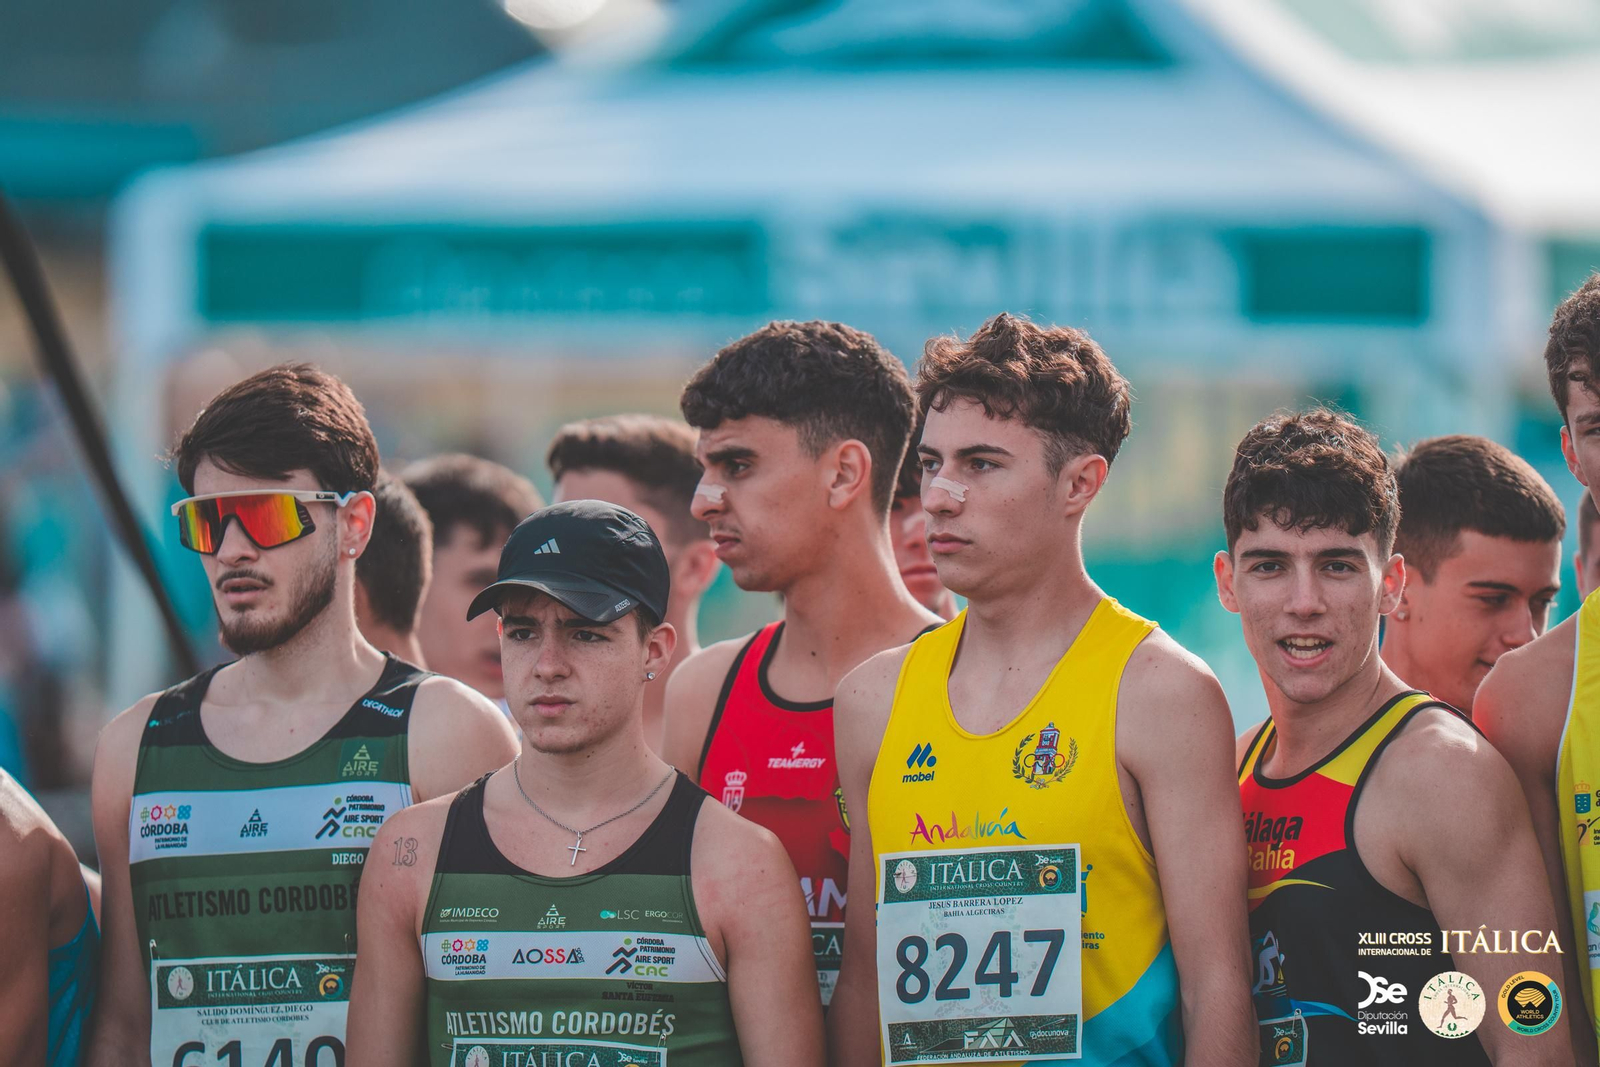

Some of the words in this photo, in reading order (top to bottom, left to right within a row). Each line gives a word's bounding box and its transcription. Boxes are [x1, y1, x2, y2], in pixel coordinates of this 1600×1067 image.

[902, 771, 935, 783] mobel
[346, 794, 374, 803] CÓRDOBA
[343, 815, 360, 823] AIRE
[361, 815, 384, 823] SPORT
[140, 822, 189, 838] CÓRDOBA
[342, 826, 377, 838] CAC
[909, 807, 1027, 845] Andalucía
[1242, 811, 1304, 851] álaga
[392, 837, 419, 867] 13
[332, 853, 364, 865] DIEGO
[929, 856, 1023, 885] ITÁLICA
[148, 888, 250, 922] ATLETISMO
[258, 877, 359, 914] CORDOBÉ
[928, 900, 951, 910] JESUS
[952, 898, 992, 908] BARRERA
[993, 896, 1023, 906] LOPEZ
[452, 907, 499, 918] IMDECO
[617, 909, 640, 920] LSC
[943, 909, 964, 918] BAHIA
[965, 908, 1005, 916] ALGECIRAS
[636, 937, 664, 946] CÓRDOBA
[640, 945, 676, 954] PATRIMONIO
[441, 953, 487, 965] CÓRDOBA
[512, 948, 579, 964] AOSSA
[635, 955, 651, 963] AIRE
[653, 955, 675, 964] SPORT
[634, 965, 668, 977] CAC
[896, 929, 1065, 1004] 8247
[206, 964, 303, 992] ITÁLICA
[197, 1007, 228, 1017] SALIDO
[284, 1004, 314, 1013] DIEGO
[231, 1016, 271, 1025] ATLETISMO
[446, 1011, 543, 1036] ATLETISMO
[551, 1008, 676, 1036] CORDOBÉS
